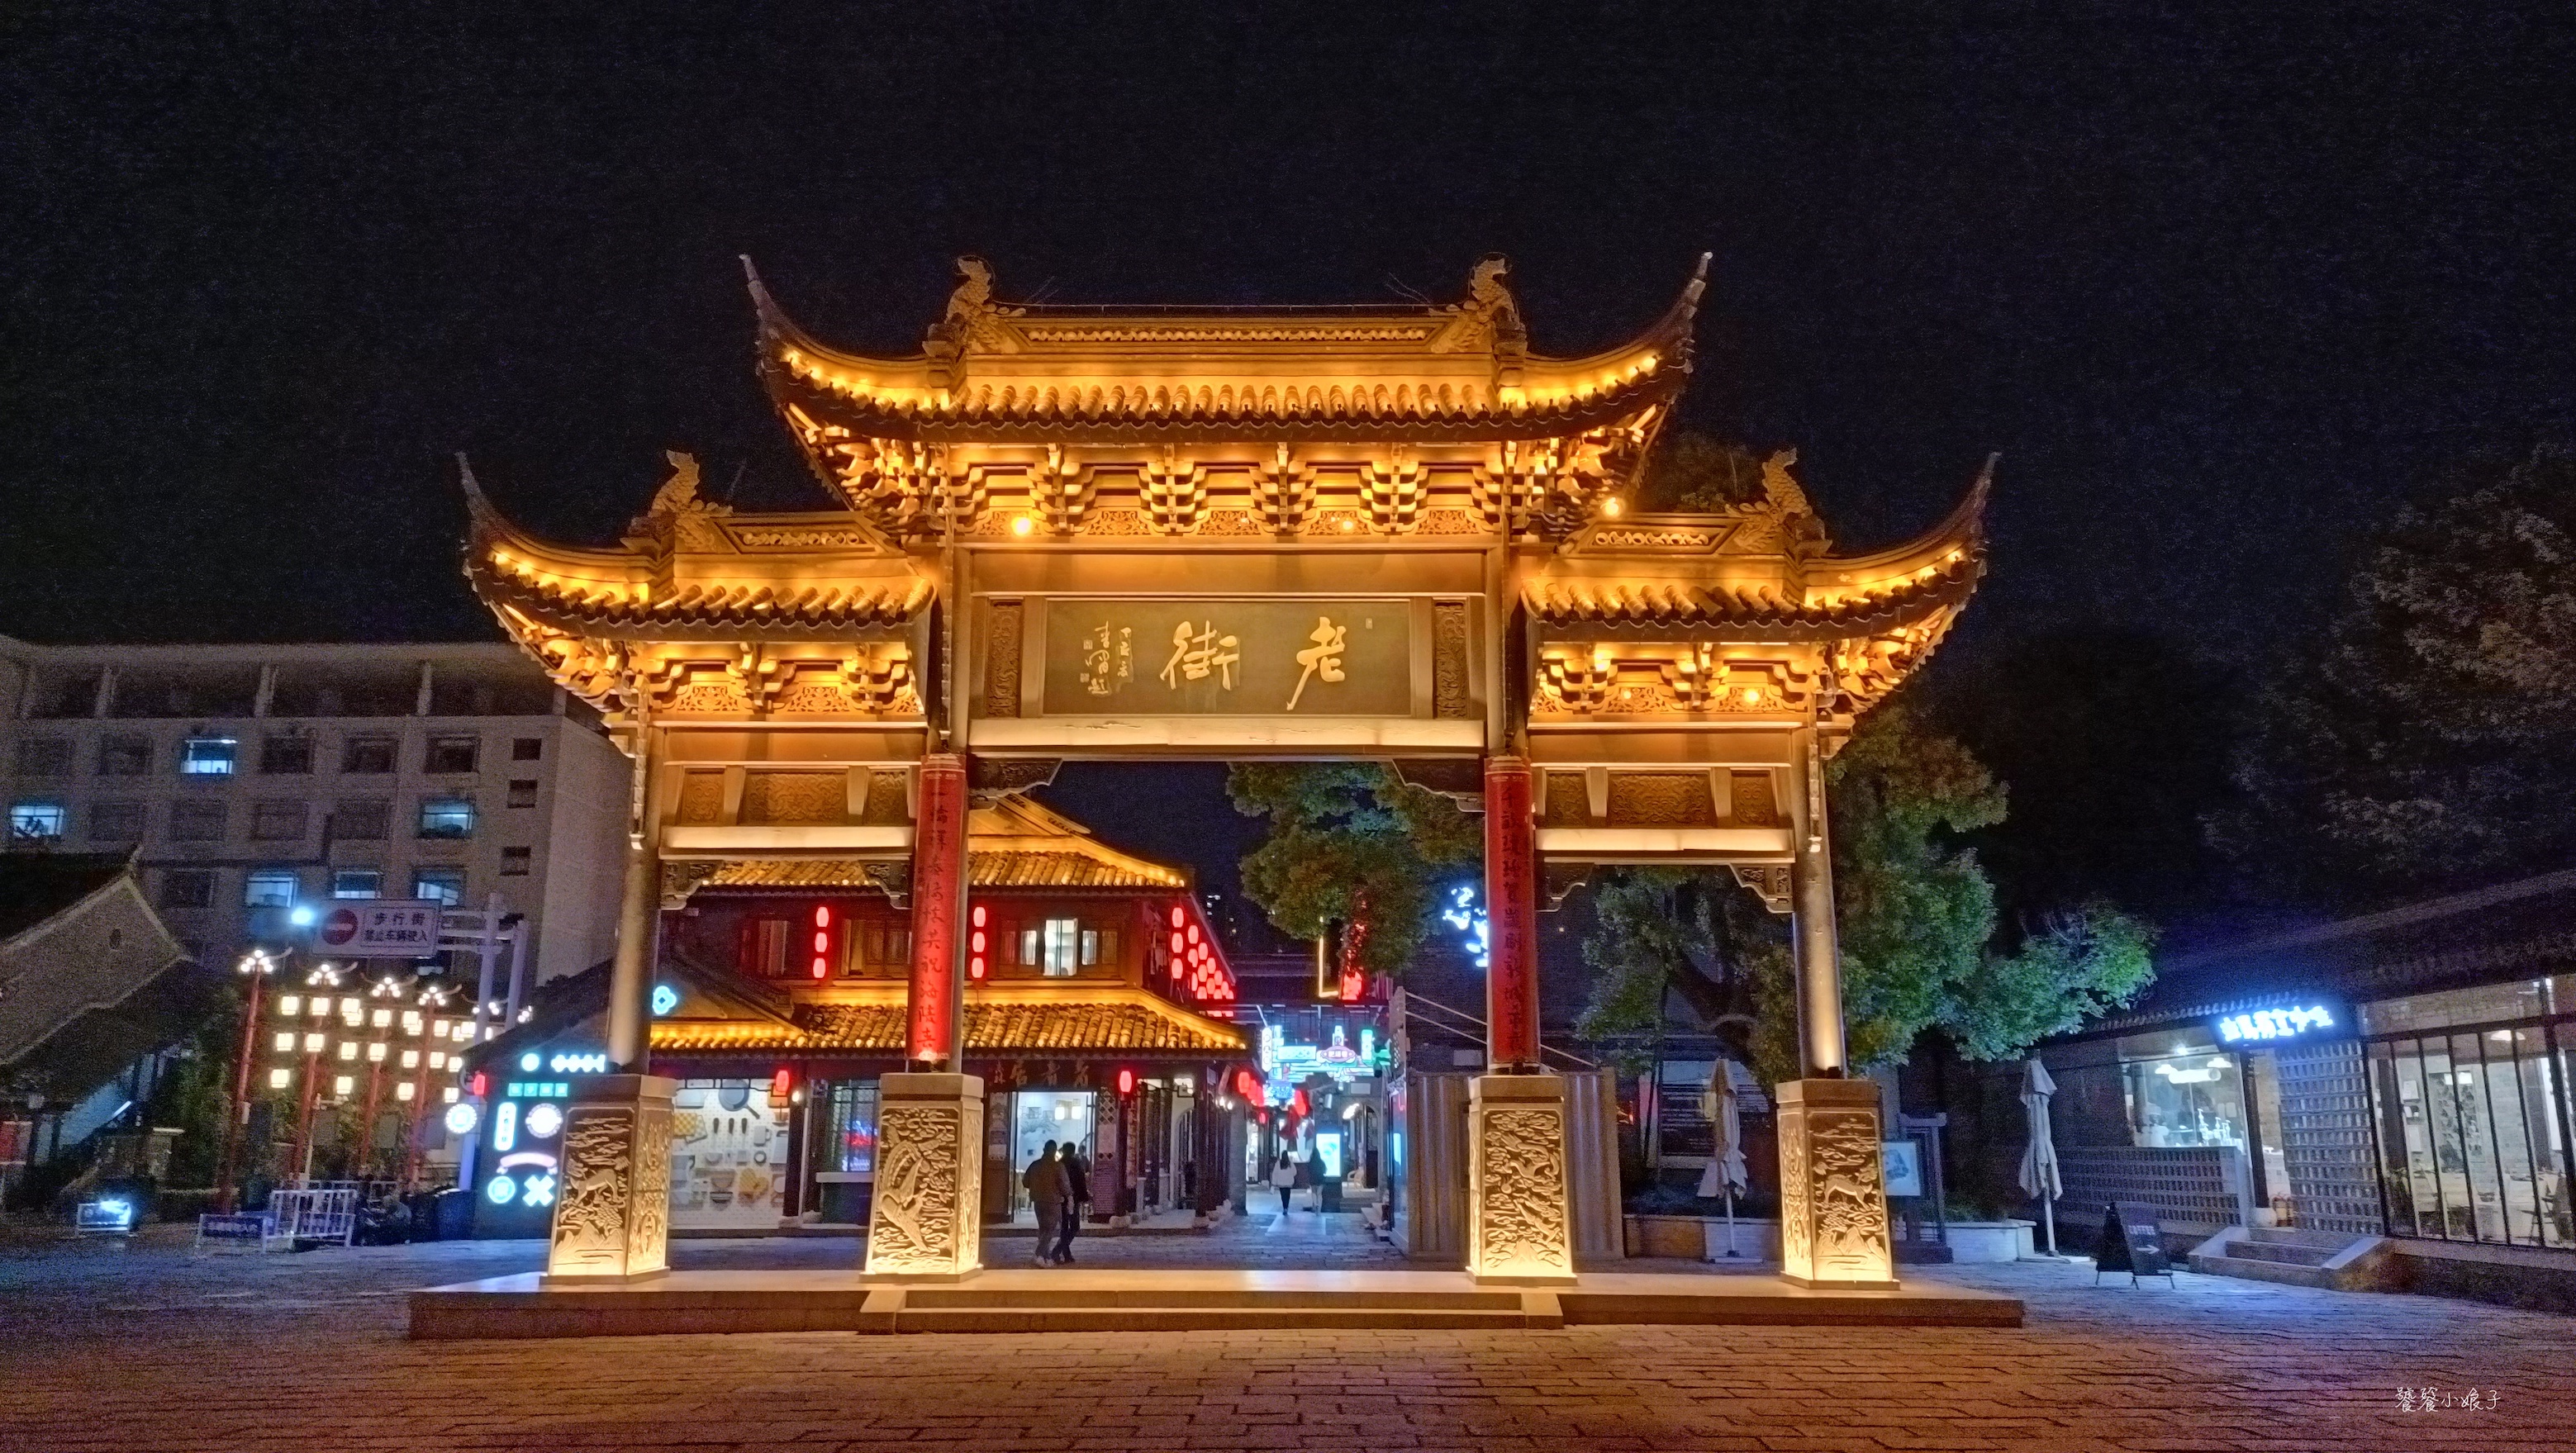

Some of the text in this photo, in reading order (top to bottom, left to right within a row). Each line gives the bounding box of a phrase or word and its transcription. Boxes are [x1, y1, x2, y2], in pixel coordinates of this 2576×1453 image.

[1160, 617, 1347, 710] 老街
[373, 912, 425, 926] 步行街
